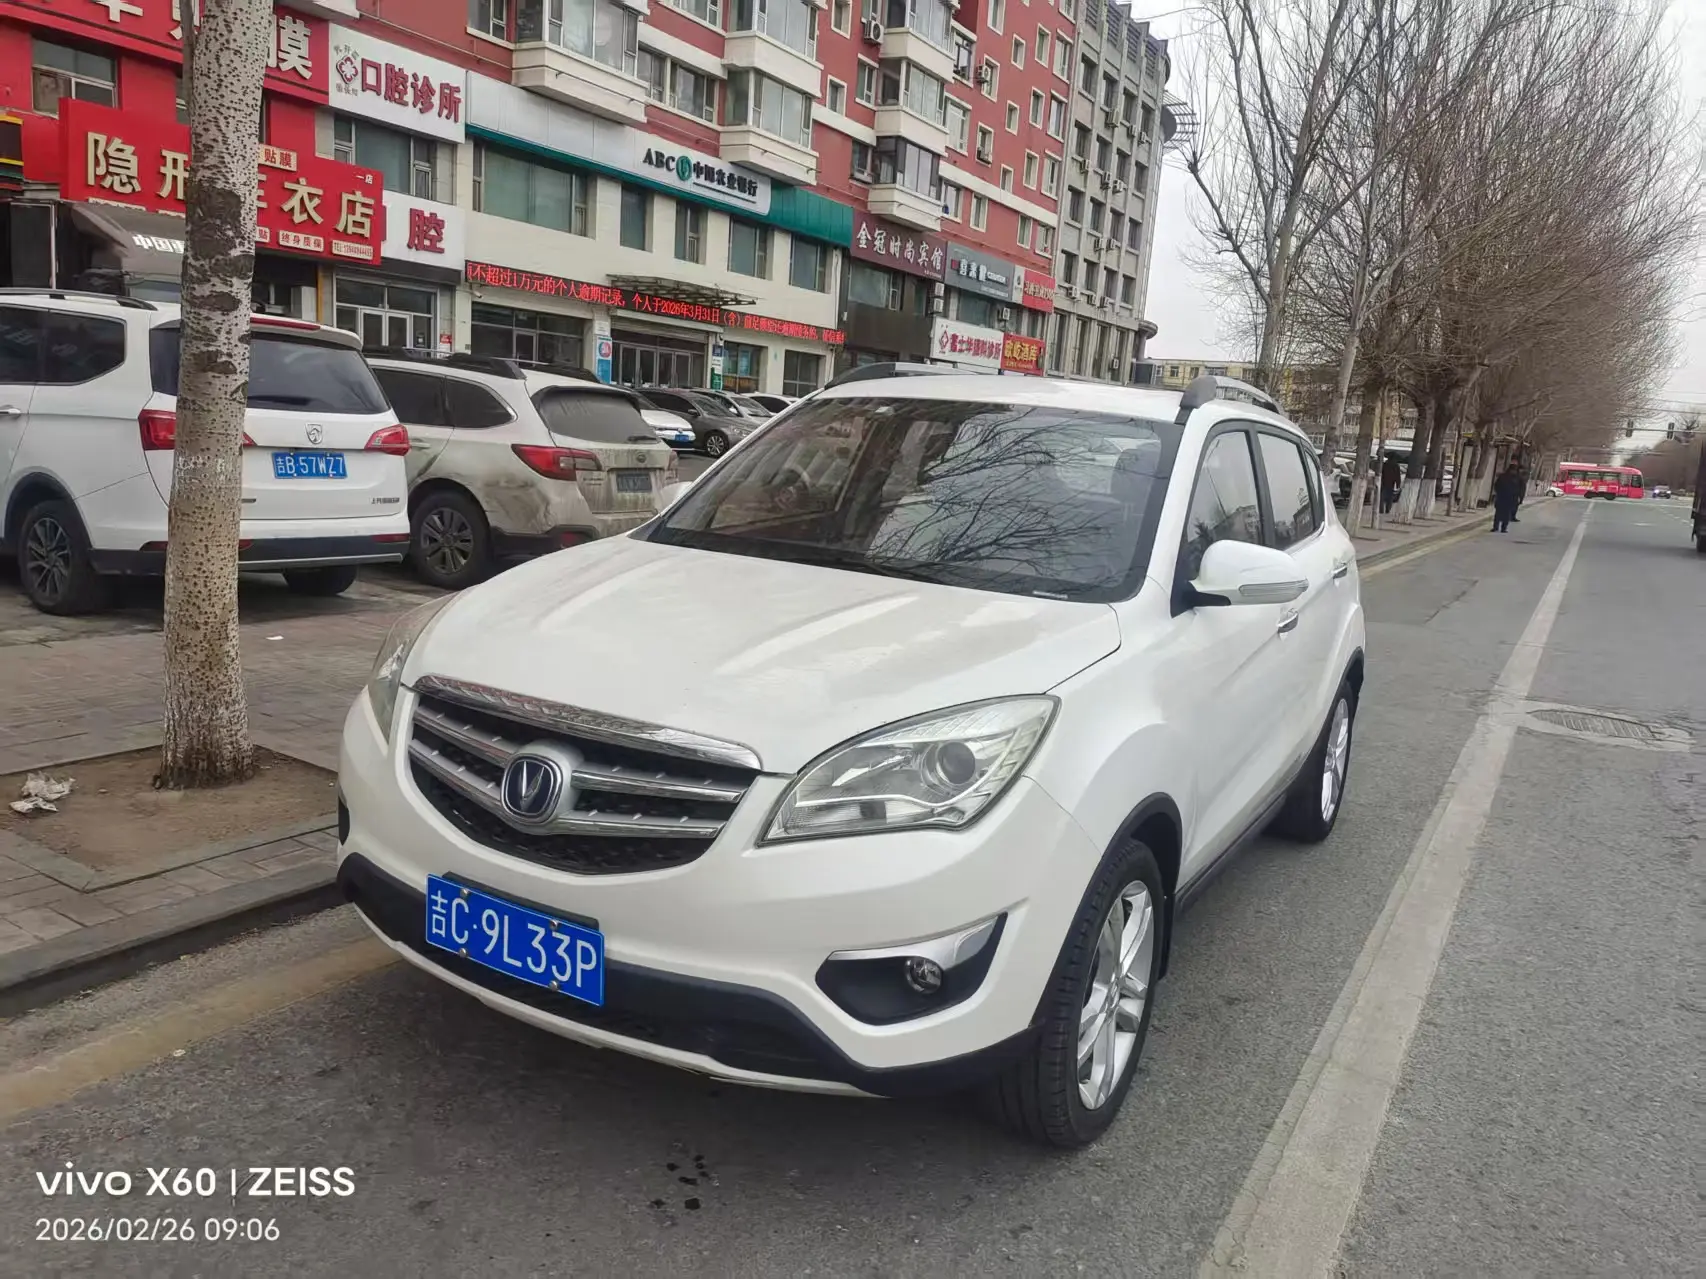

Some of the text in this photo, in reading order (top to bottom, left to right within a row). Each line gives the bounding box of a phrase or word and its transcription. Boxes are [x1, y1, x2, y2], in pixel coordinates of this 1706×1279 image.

[361, 57, 461, 123] 口腔诊所
[356, 174, 373, 185] 一店
[642, 148, 676, 172] ABC
[382, 206, 445, 254] 腔
[856, 221, 944, 271] 金冠时尚宾馆
